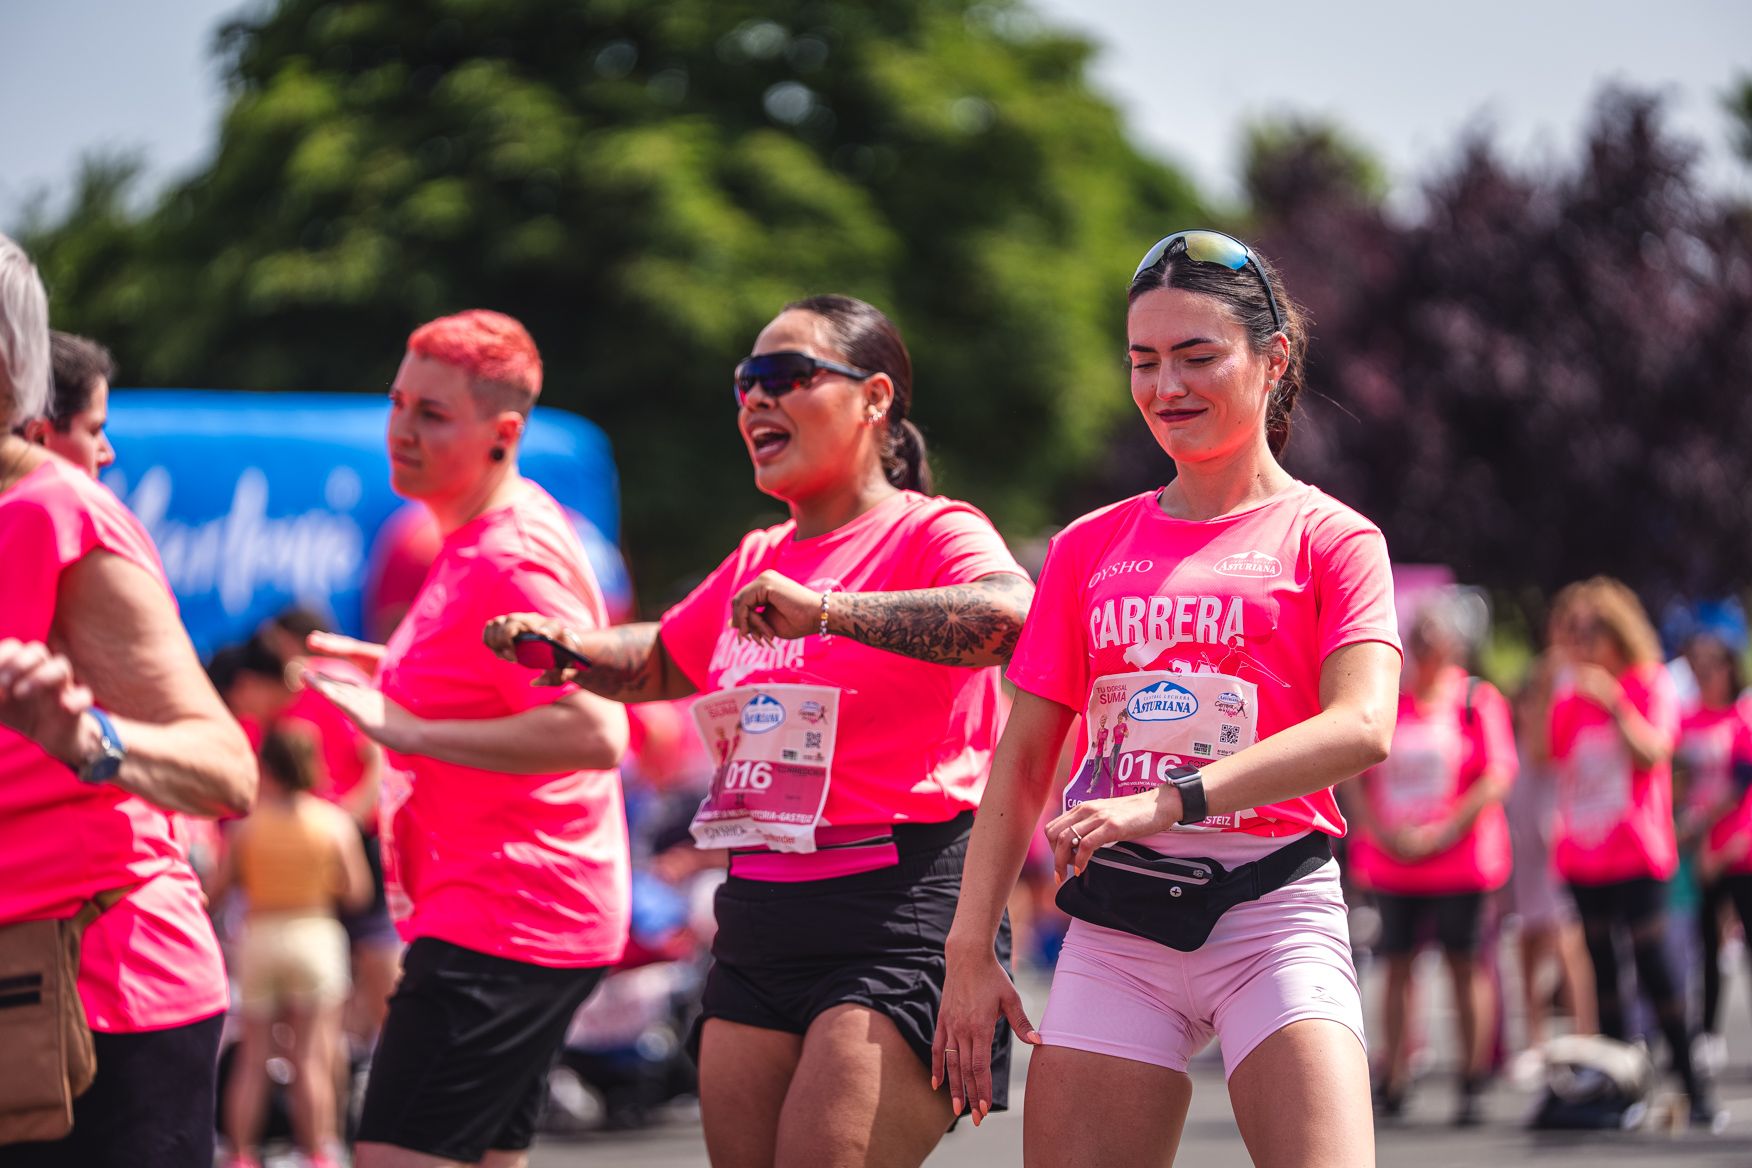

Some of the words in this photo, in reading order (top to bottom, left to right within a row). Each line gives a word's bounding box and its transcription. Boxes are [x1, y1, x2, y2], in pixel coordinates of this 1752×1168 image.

[1088, 559, 1154, 588] OYSHO
[1219, 560, 1276, 575] ASTURIANA
[1089, 595, 1245, 650] CARRERA
[1099, 691, 1126, 705] SUMA
[1131, 697, 1191, 714] ASTURIANA
[724, 761, 773, 790] 016
[1117, 751, 1182, 782] 016
